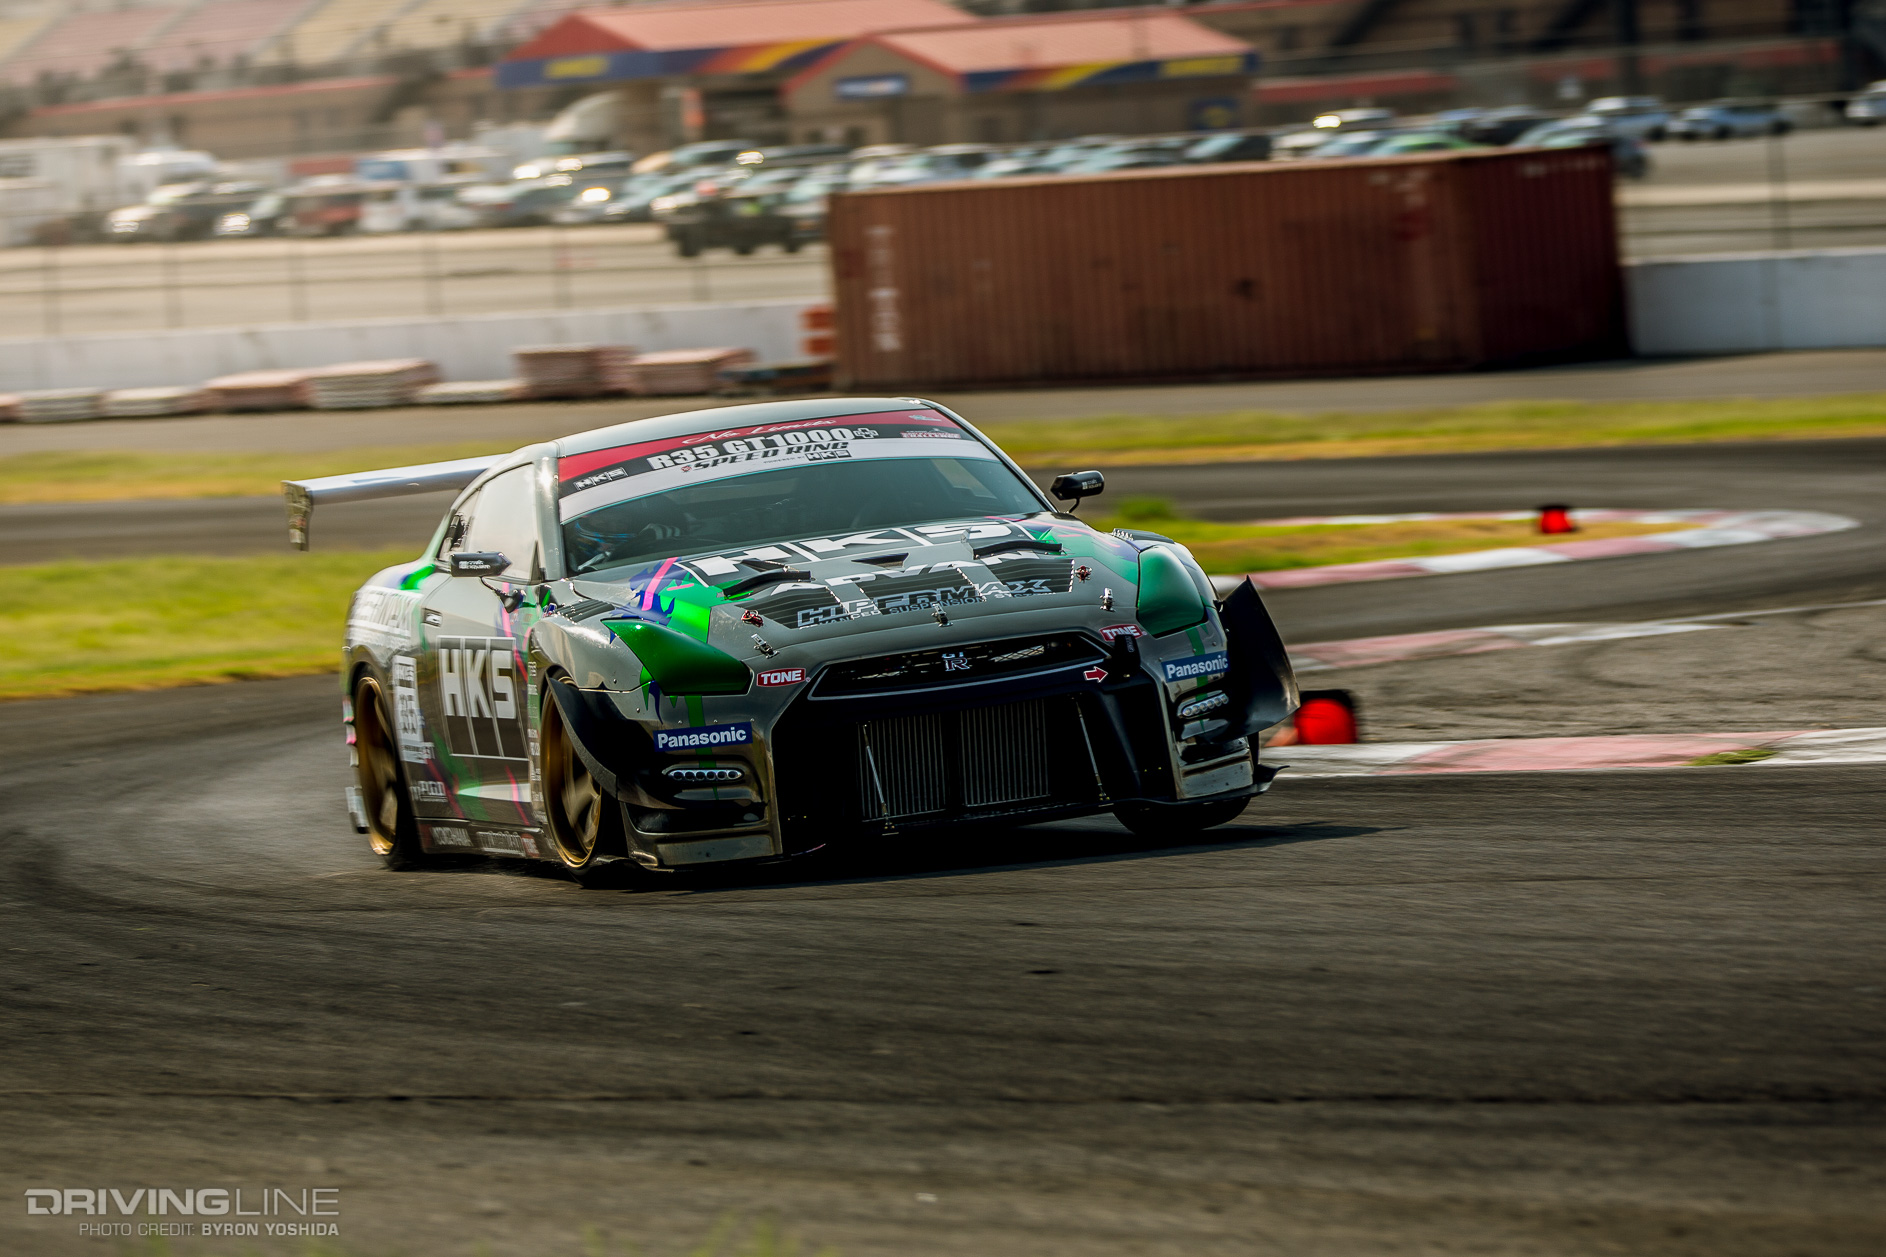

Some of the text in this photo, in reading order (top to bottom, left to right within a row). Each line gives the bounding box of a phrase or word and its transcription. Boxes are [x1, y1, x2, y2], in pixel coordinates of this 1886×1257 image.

[647, 444, 721, 471] R35
[693, 442, 849, 471] SPEED RING
[805, 449, 852, 462] HKS
[573, 467, 628, 490] HKS
[691, 523, 1012, 577] HKS
[761, 669, 802, 685] TONE
[1166, 654, 1229, 679] Panasonic
[438, 648, 518, 720] HKS
[657, 726, 747, 749] Panasonic
